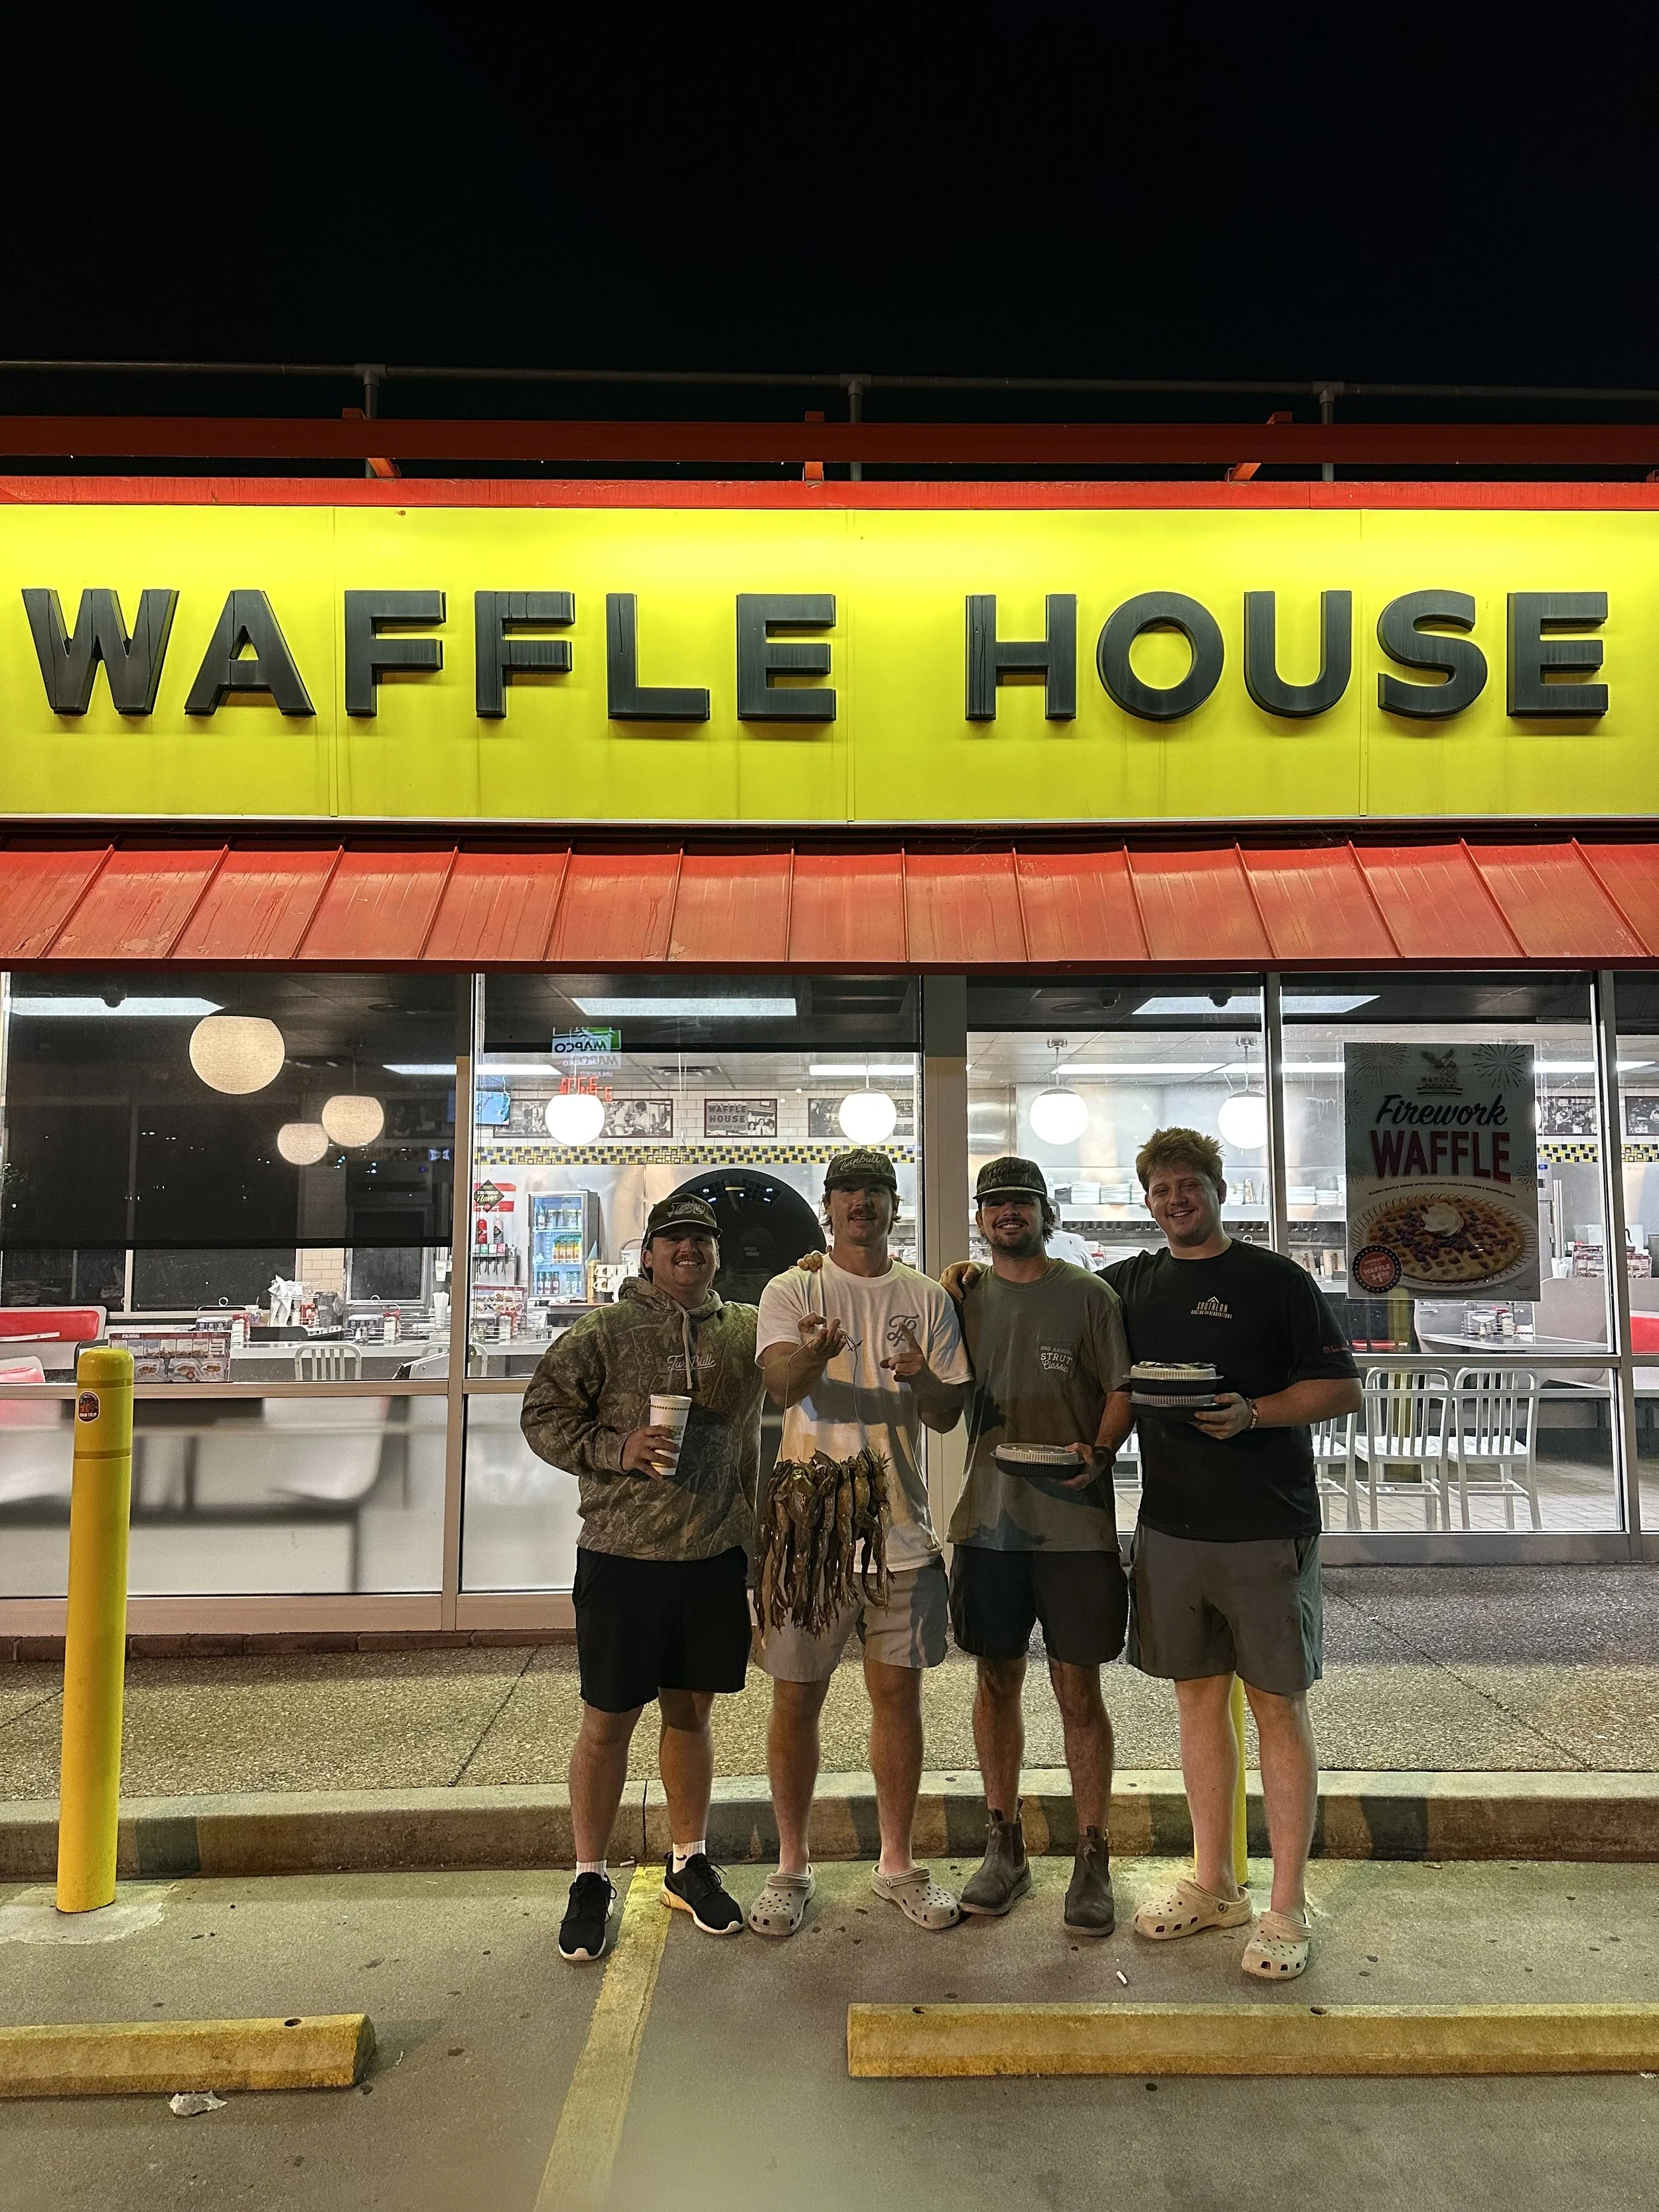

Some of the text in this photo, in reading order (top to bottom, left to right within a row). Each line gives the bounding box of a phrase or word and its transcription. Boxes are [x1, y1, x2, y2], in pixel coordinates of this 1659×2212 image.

[21, 588, 1609, 721] WAFFLE HOUSE
[708, 1104, 747, 1113] WAFFLE
[1376, 1094, 1508, 1126] Firework
[1370, 1130, 1511, 1183] WAFFLE
[1363, 1264, 1391, 1275] WAFFLE
[1196, 1301, 1228, 1313] SOUTHERN
[1041, 1353, 1072, 1364] STRUT
[1042, 1360, 1068, 1372] Classic
